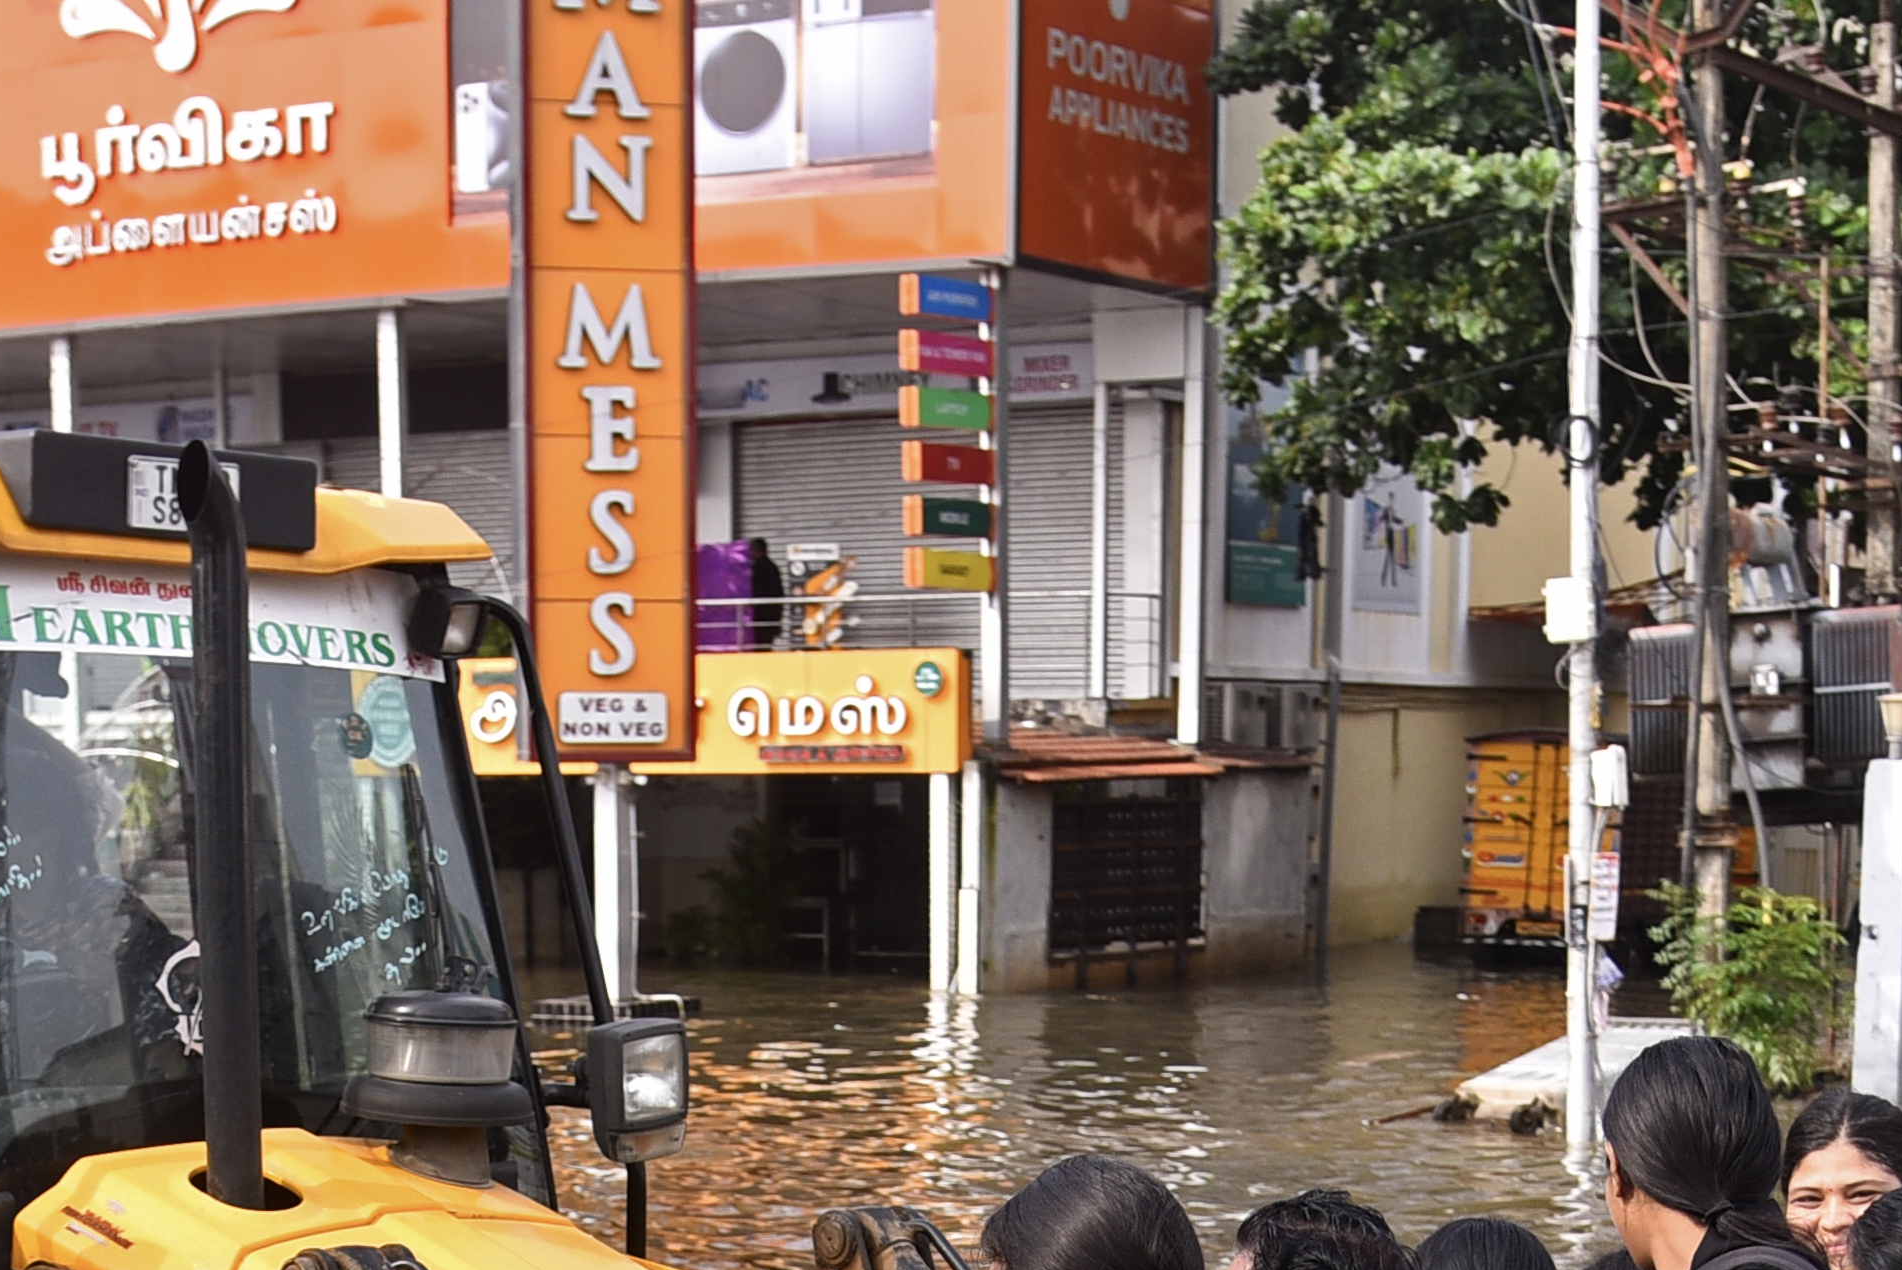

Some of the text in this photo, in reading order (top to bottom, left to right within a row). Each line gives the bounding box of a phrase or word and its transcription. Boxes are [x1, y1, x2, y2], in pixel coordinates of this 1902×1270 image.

[1047, 26, 1191, 105] POORVIKA
[41, 95, 335, 206] பூர்விகா
[1048, 85, 1191, 154] APPLIANCES
[553, 0, 662, 678] AN MESS
[90, 573, 152, 596] சிவன்
[250, 617, 397, 668] OVERS
[562, 721, 664, 737] NON VEG
[578, 698, 648, 714] VEG &
[727, 674, 907, 738] மெஸ்
